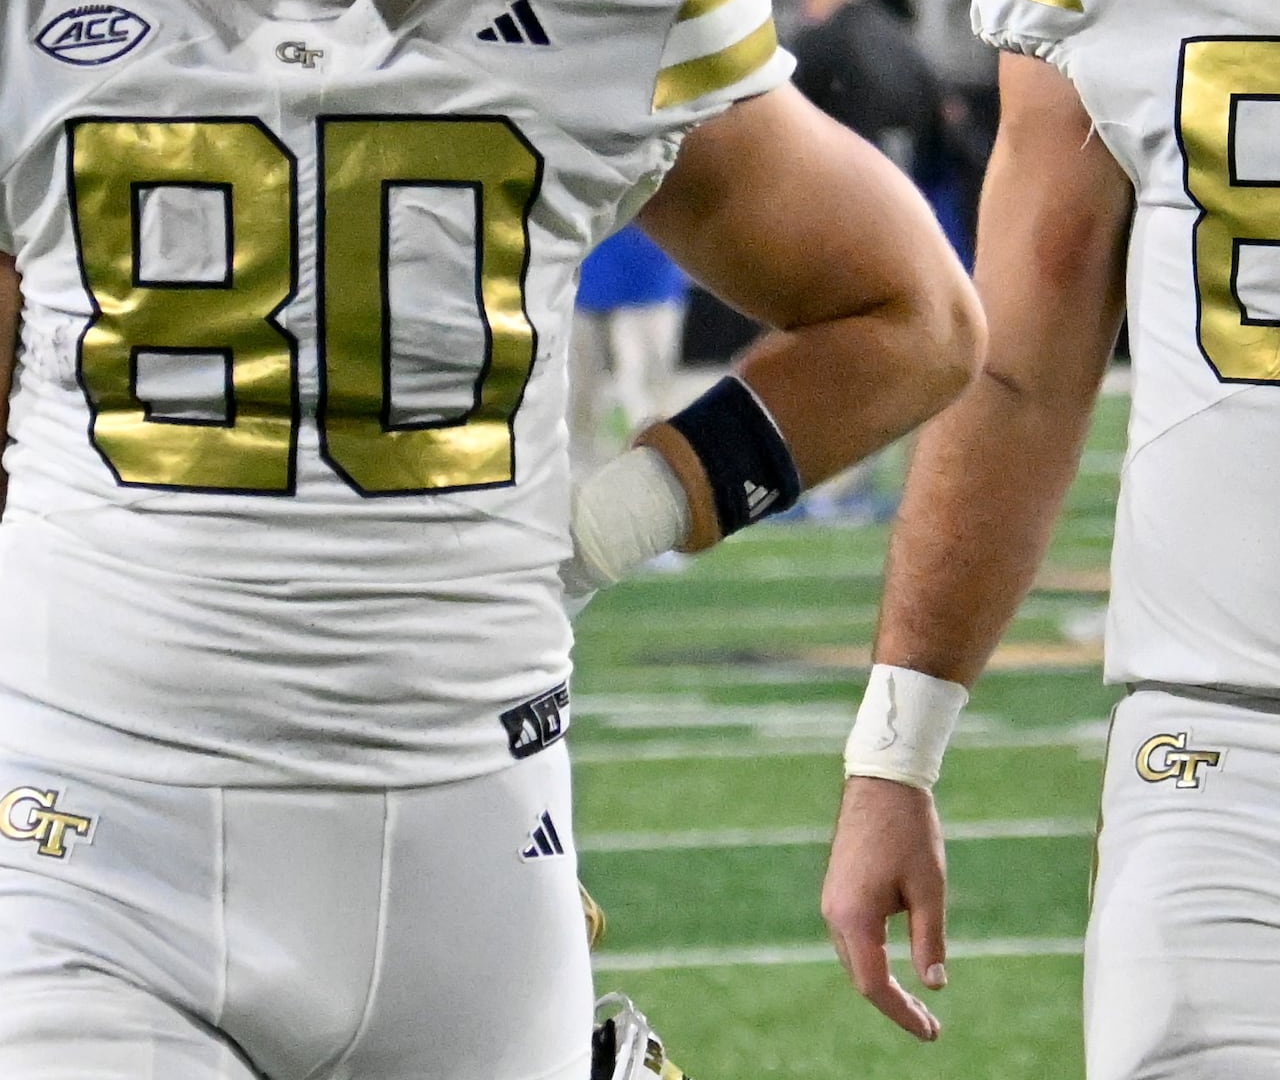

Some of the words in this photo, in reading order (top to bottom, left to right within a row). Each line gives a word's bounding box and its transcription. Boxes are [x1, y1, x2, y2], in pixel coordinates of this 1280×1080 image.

[53, 15, 129, 45] ACC
[275, 41, 324, 69] GT
[65, 115, 544, 498] 80
[1135, 731, 1221, 789] GT
